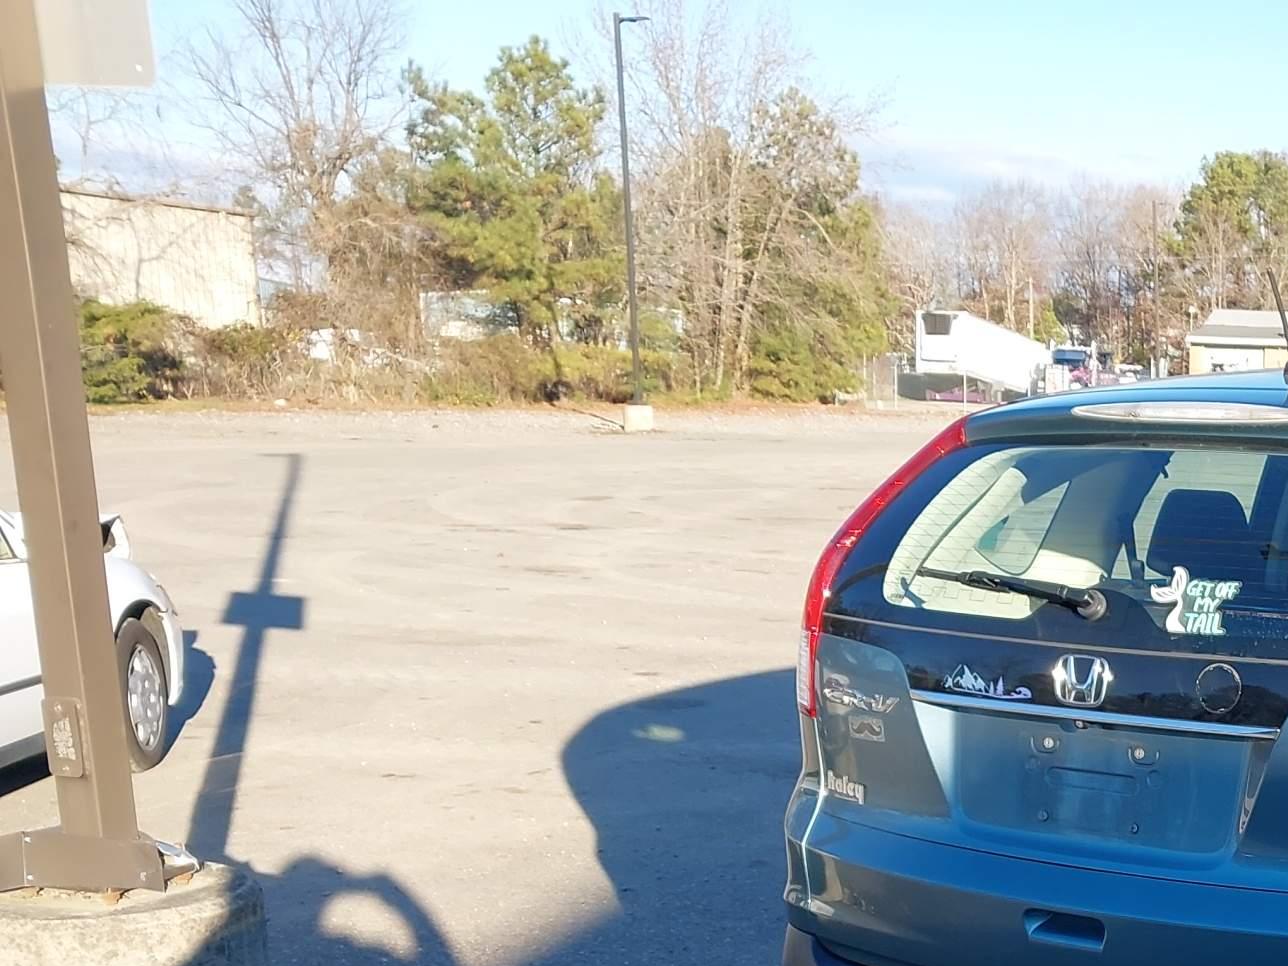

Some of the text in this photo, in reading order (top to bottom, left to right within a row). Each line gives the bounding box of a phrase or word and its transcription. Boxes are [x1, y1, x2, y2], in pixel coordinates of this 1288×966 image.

[1186, 580, 1241, 600] GET OFF
[1193, 596, 1222, 613] MY
[1184, 611, 1226, 635] TAIL
